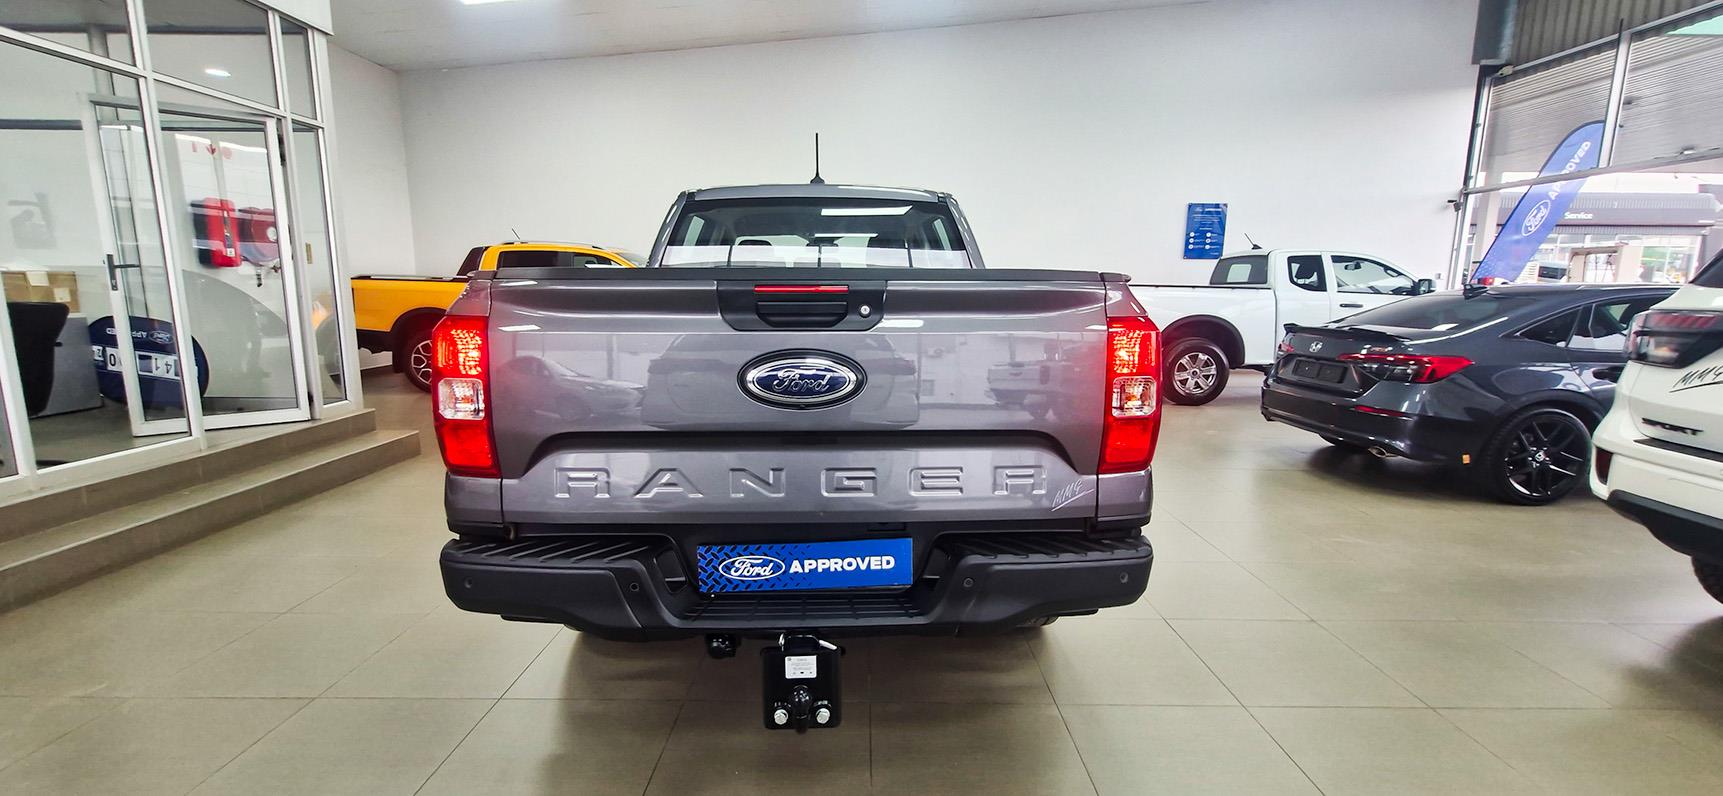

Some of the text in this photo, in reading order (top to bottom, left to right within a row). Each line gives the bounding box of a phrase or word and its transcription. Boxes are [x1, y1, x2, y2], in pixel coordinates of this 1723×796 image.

[1525, 204, 1549, 232] Ford
[1564, 212, 1593, 220] Service
[773, 368, 830, 392] Ford
[1642, 417, 1704, 436] SPORT
[554, 465, 1047, 498] RANGER
[731, 555, 896, 578] Ford APPROVED
